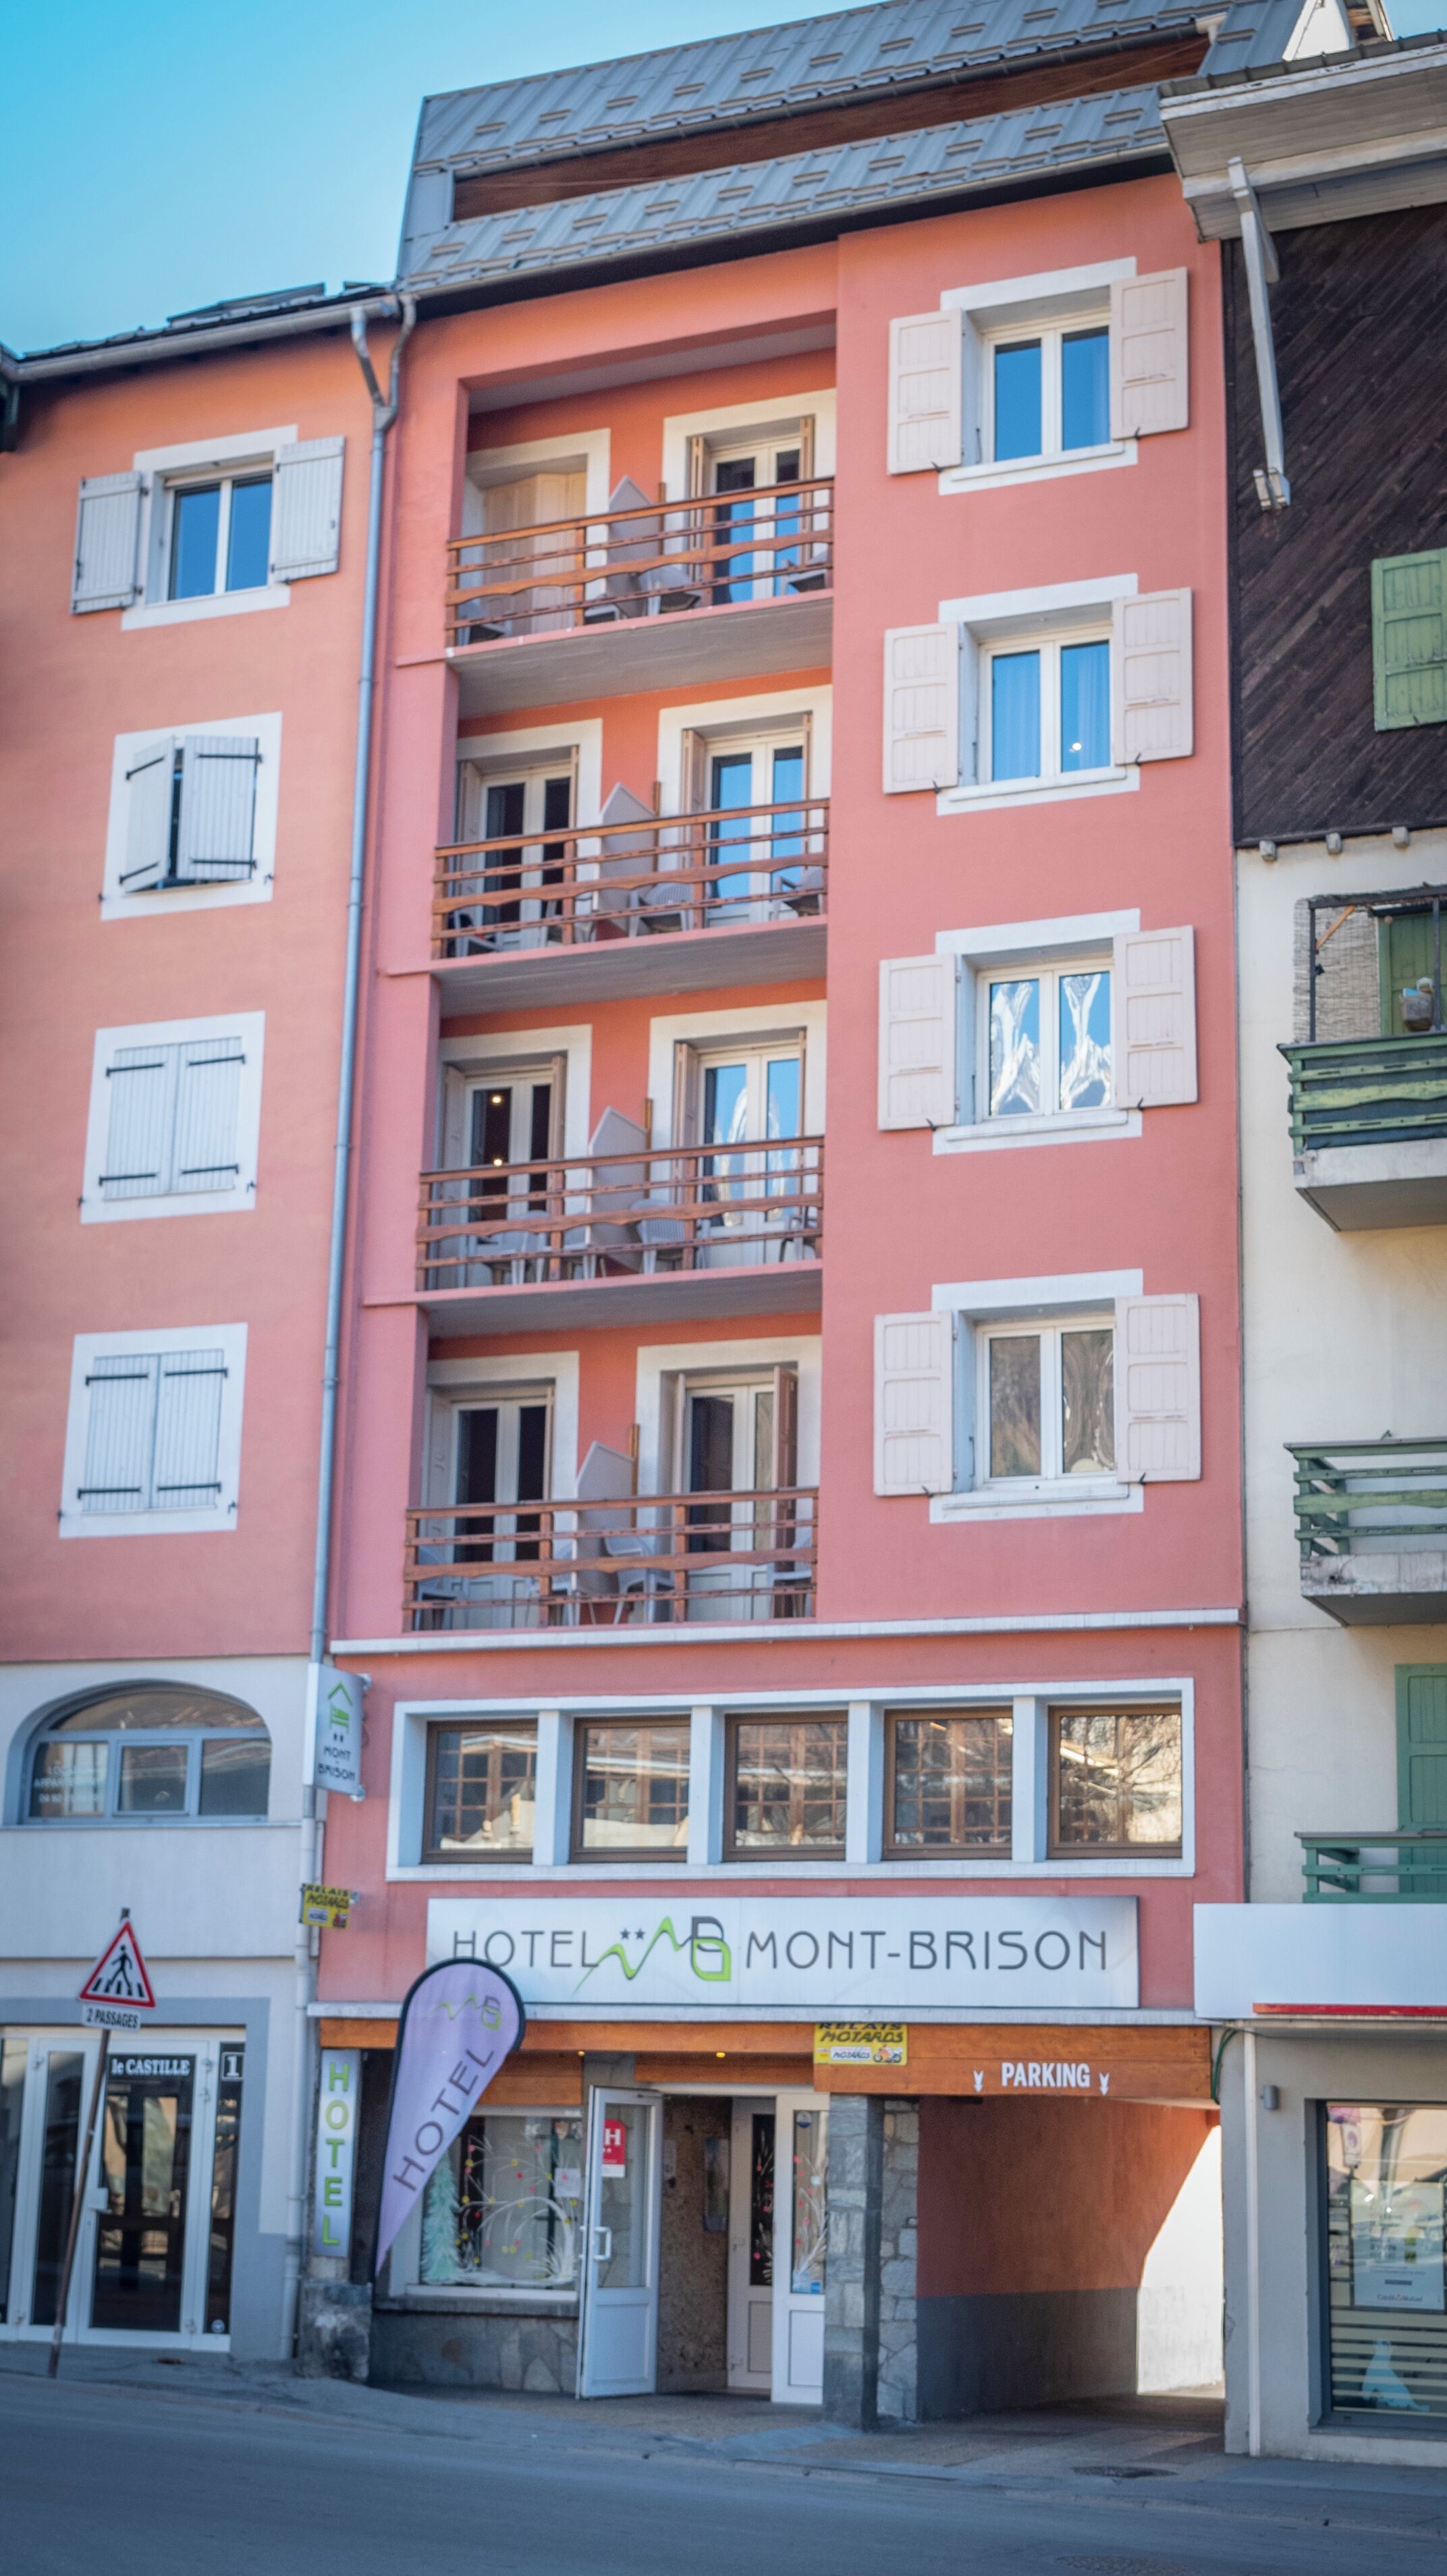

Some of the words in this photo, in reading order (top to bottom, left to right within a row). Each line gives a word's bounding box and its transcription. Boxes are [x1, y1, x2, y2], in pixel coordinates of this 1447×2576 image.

[324, 1745, 351, 1761] MONT
[318, 1763, 356, 1780] BRISON
[454, 1930, 600, 1967] HOTEL
[746, 1930, 1107, 1971] MONT-BRISON
[86, 2008, 93, 2023] 2
[94, 2010, 138, 2029] PASSAGES
[820, 2031, 904, 2043] MOTARDS
[111, 2058, 124, 2075] le
[126, 2058, 191, 2076] CASTILLE
[1000, 2062, 1091, 2088] PARKING
[393, 2048, 495, 2192] HOTEL
[604, 2128, 622, 2146] H
[322, 2062, 350, 2246] HOTEL
